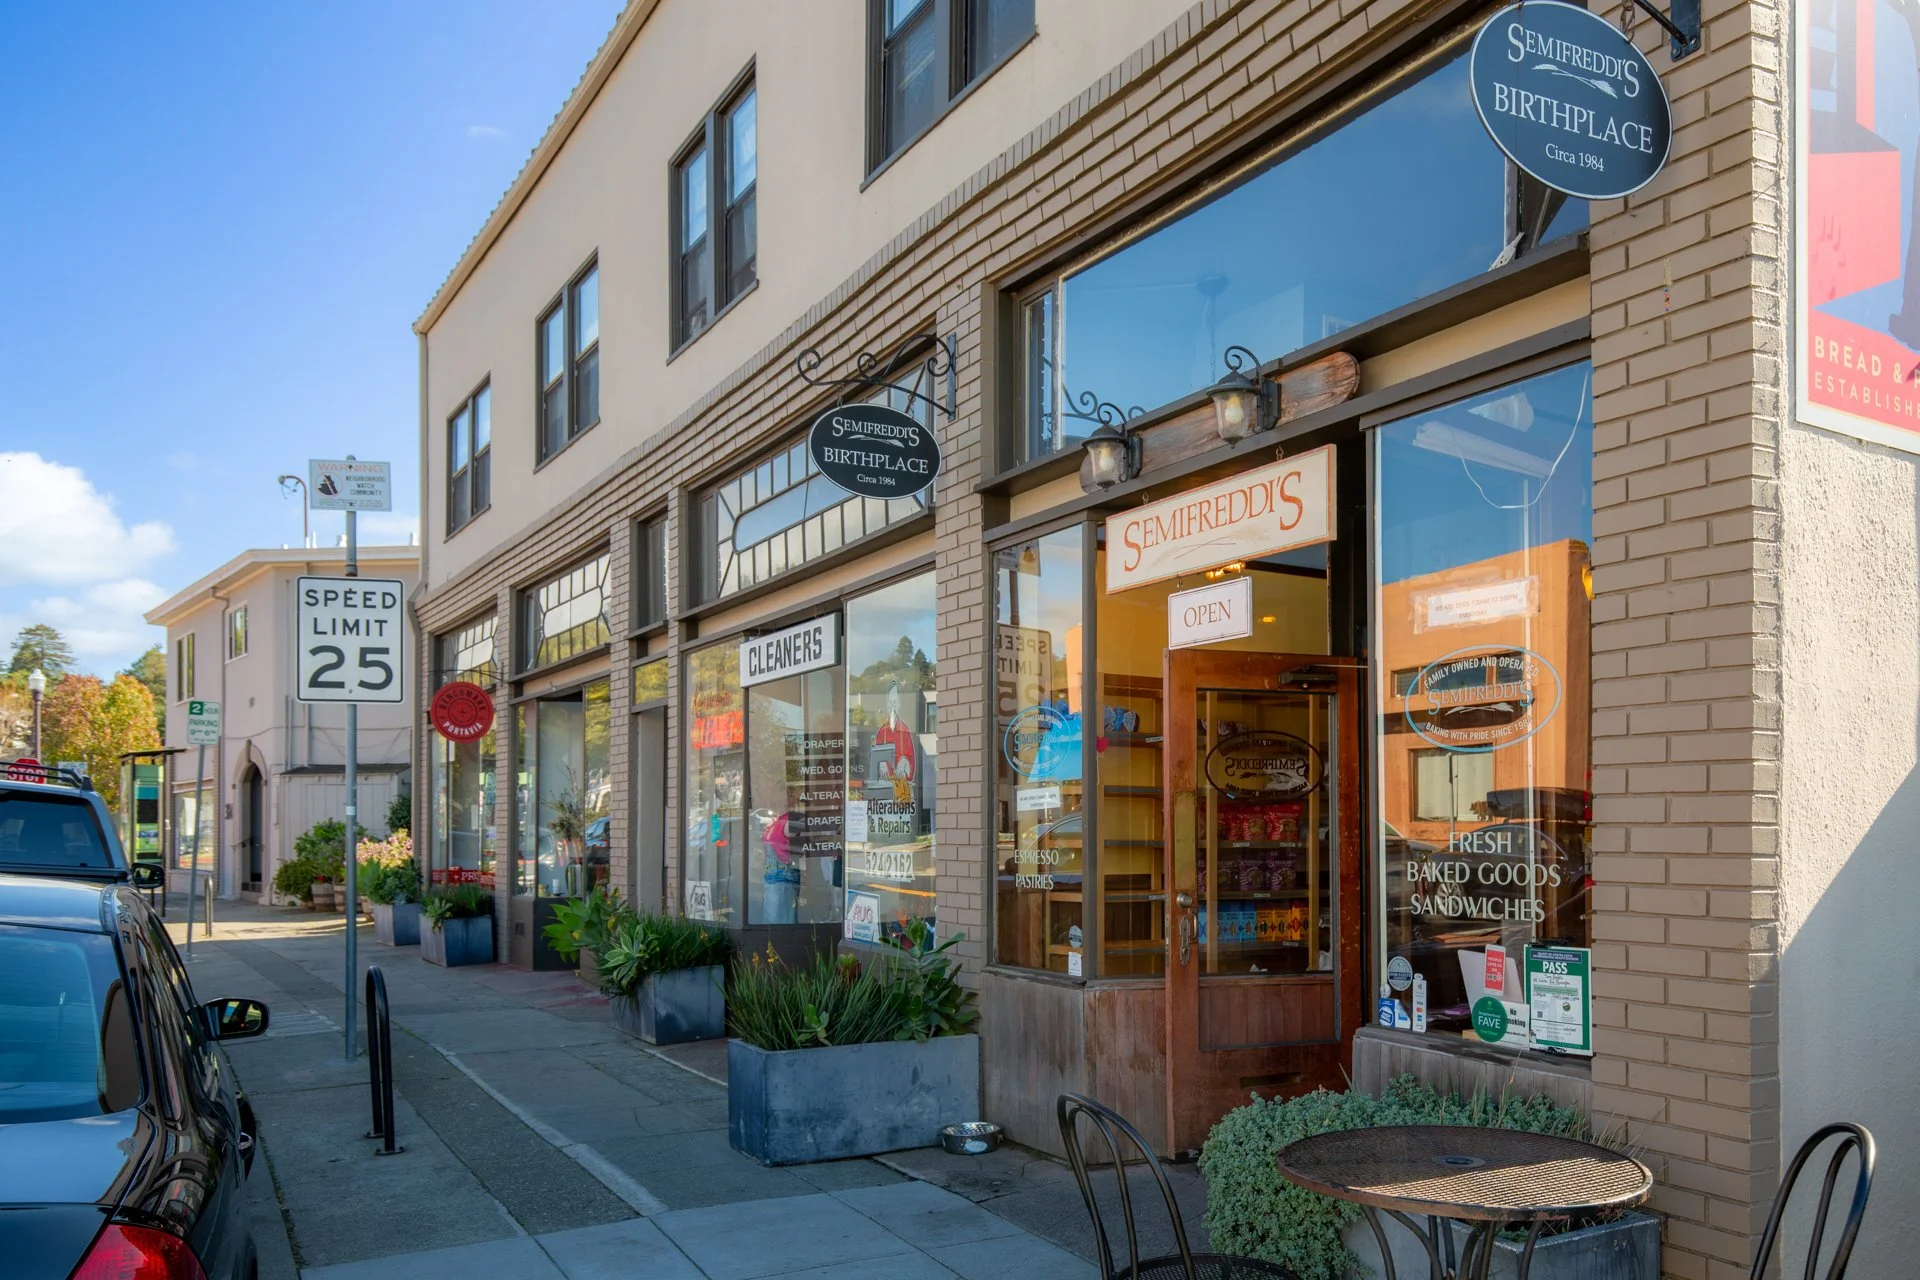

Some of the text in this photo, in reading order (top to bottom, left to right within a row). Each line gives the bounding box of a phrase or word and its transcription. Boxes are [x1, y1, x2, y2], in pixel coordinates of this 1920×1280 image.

[1507, 23, 1640, 98] SEMIFREDDI'S
[1493, 82, 1653, 153] BIRTHPLACE
[1545, 143, 1604, 172] Circa 1984
[1814, 335, 1882, 377] BREAD
[1893, 361, 1903, 384] &
[832, 416, 920, 447] SEMIFREDDI'S
[823, 446, 929, 474] BIRTHPLACE
[856, 473, 896, 486] Circa 1984
[1124, 470, 1304, 573] SEMIFREDDI'S
[304, 588, 397, 609] SPEED
[1183, 599, 1232, 628] OPEN
[313, 617, 388, 637] LIMIT
[748, 626, 822, 677] CLEANERS
[308, 645, 394, 691] 25
[1424, 656, 1539, 689] FAMILY OWNED AND OPERATED
[191, 703, 202, 713] 2
[1428, 680, 1534, 716] SEMIFREDDI'S
[442, 721, 483, 736] PORTAVIA
[1425, 721, 1450, 738] BAKING
[1451, 730, 1468, 741] WITH
[1469, 732, 1489, 741] PRIDE
[1491, 725, 1512, 738] SINCE
[8, 766, 45, 782] STOP
[867, 798, 916, 816] Alterations
[869, 818, 876, 833] &
[877, 815, 911, 838] Repairs
[1449, 831, 1512, 853] FRESH
[1014, 849, 1059, 866] ESPRESSO
[1015, 874, 1054, 890] PASTRIES
[1407, 861, 1562, 887] BAKED GOODS
[1410, 894, 1546, 922] SANDWICHES
[1542, 960, 1568, 975] PASS
[1478, 1016, 1501, 1029] FAVE
[1509, 1007, 1517, 1016] No
[1507, 1018, 1526, 1028] moking
